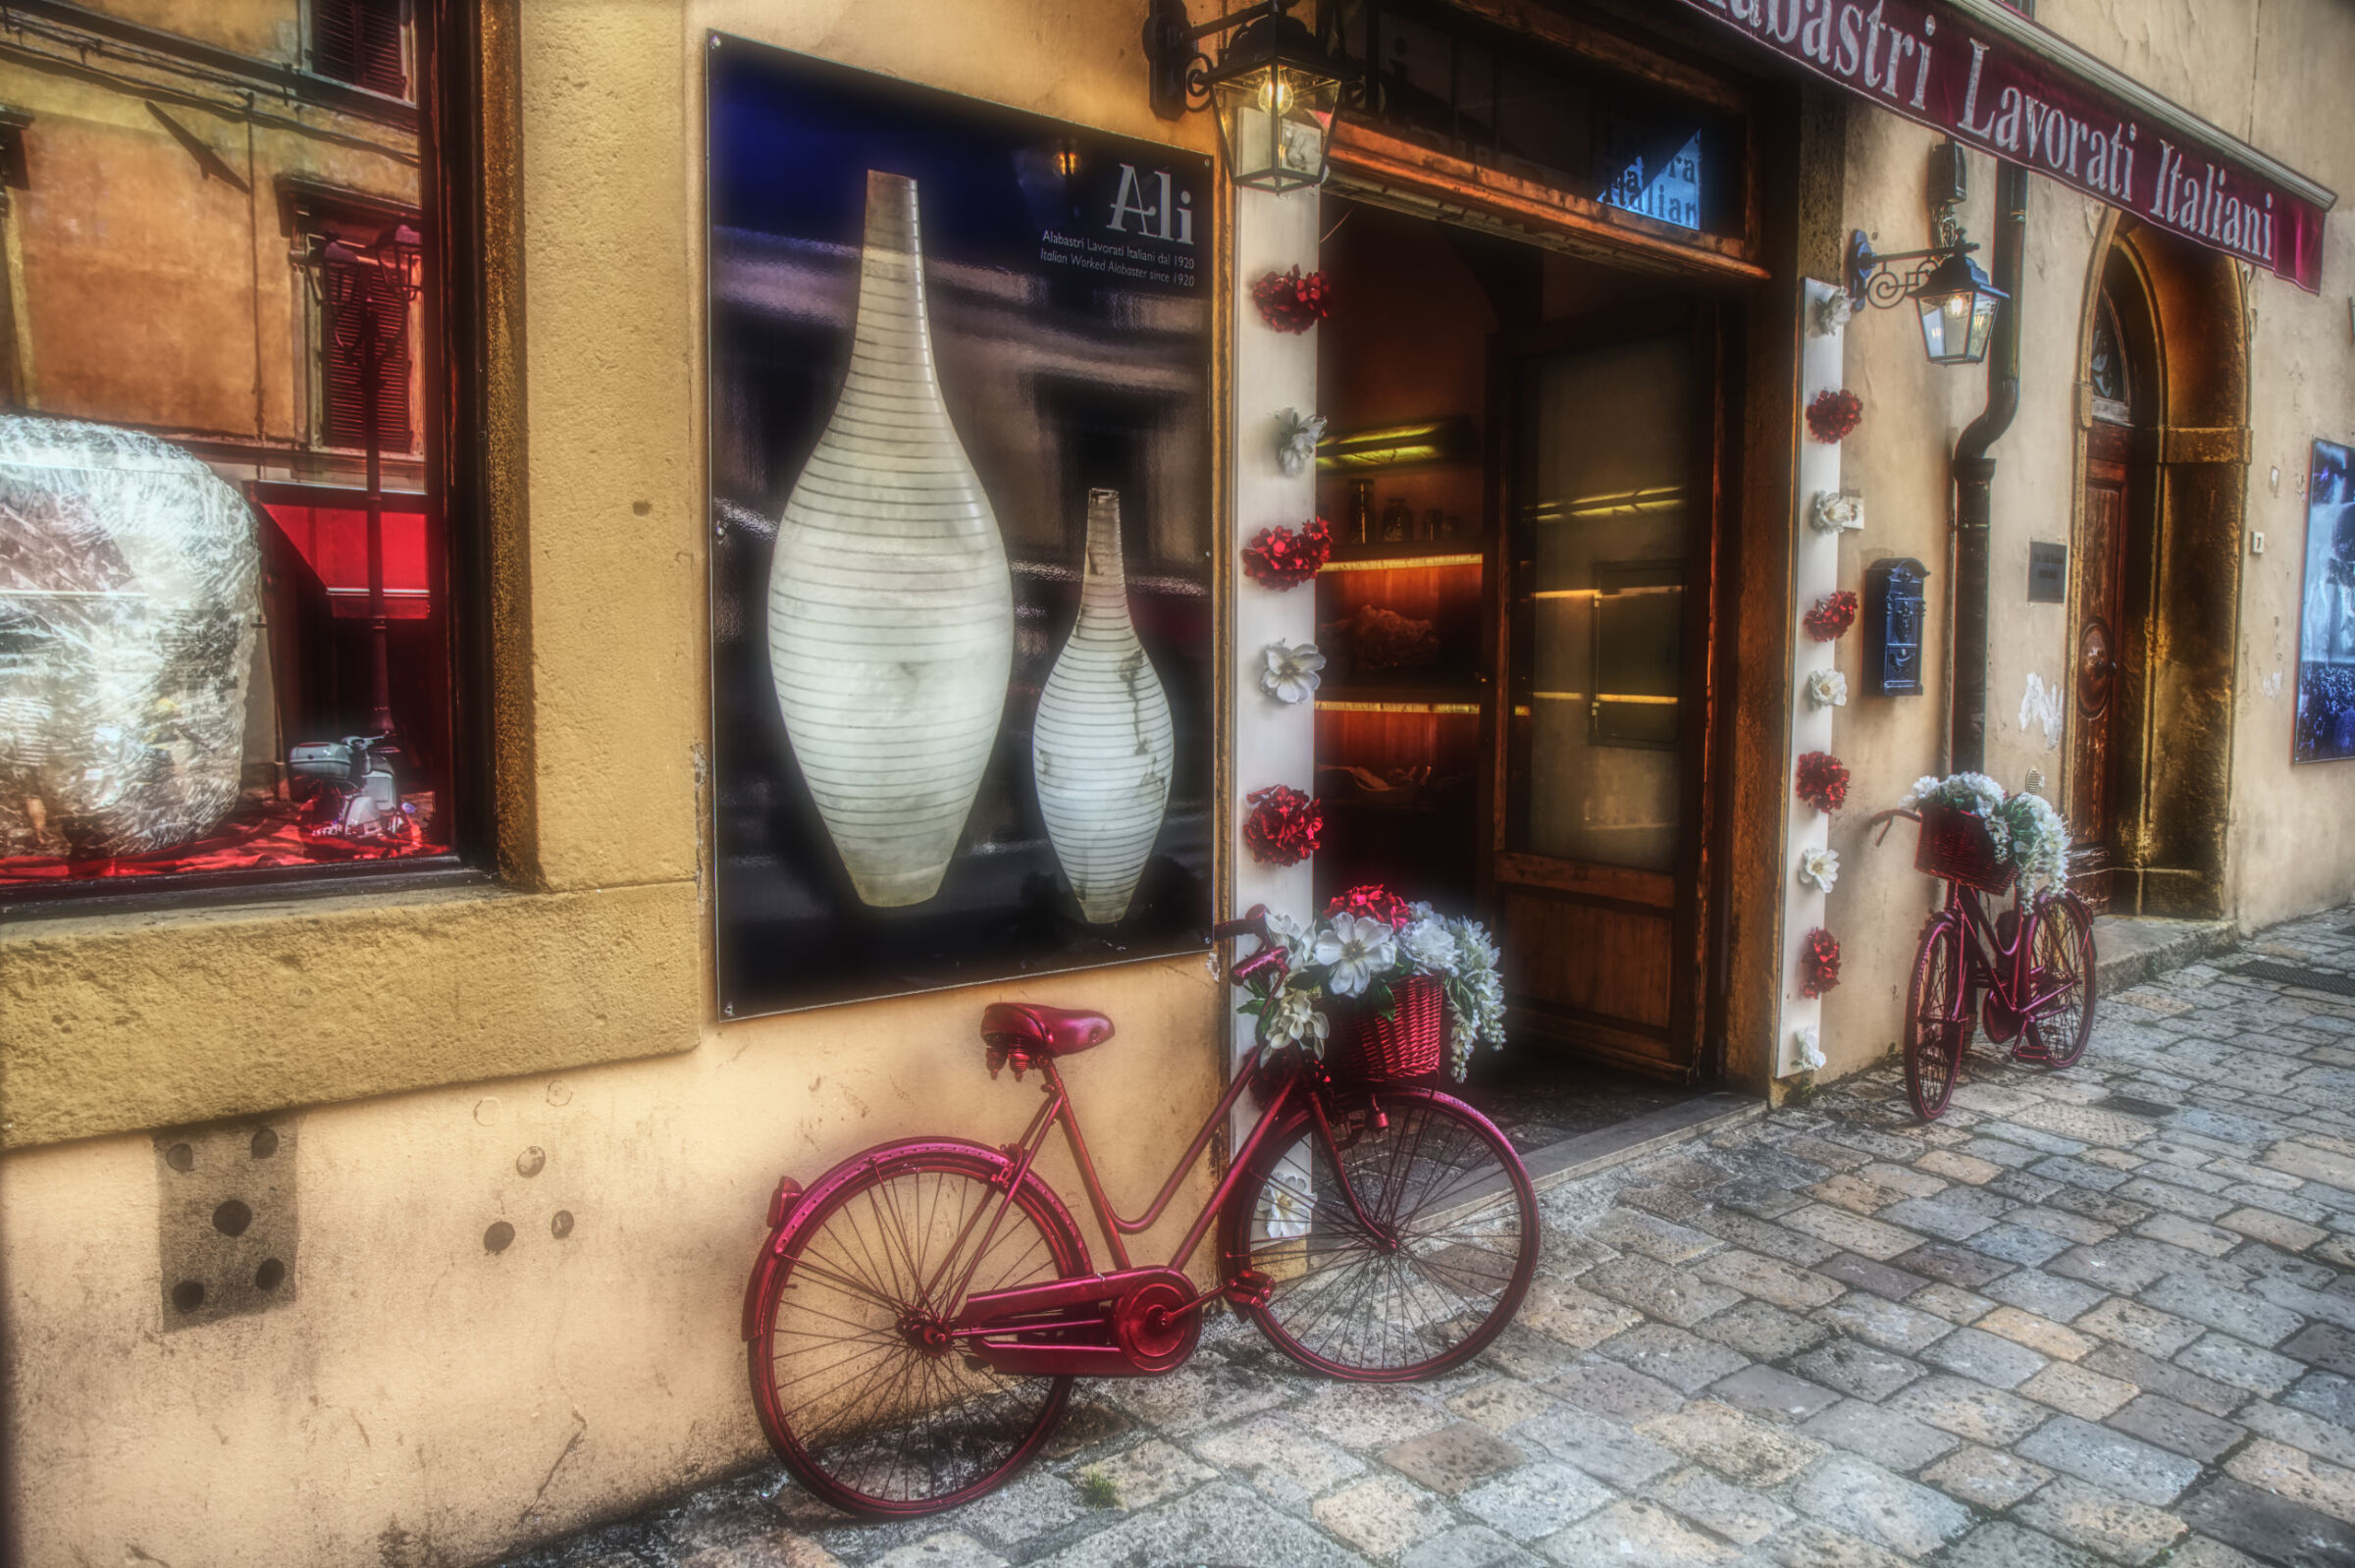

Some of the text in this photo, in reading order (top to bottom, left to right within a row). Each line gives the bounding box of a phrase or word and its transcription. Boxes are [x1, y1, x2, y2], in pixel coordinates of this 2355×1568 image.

[1709, 0, 2274, 261] bastri Lavorati Italiani
[1106, 162, 1194, 245] Ali
[1040, 247, 1194, 287] Italian Worked Alabaster since 1920
[1042, 230, 1194, 270] Alabastri Lavorati Italiani dal 1920
